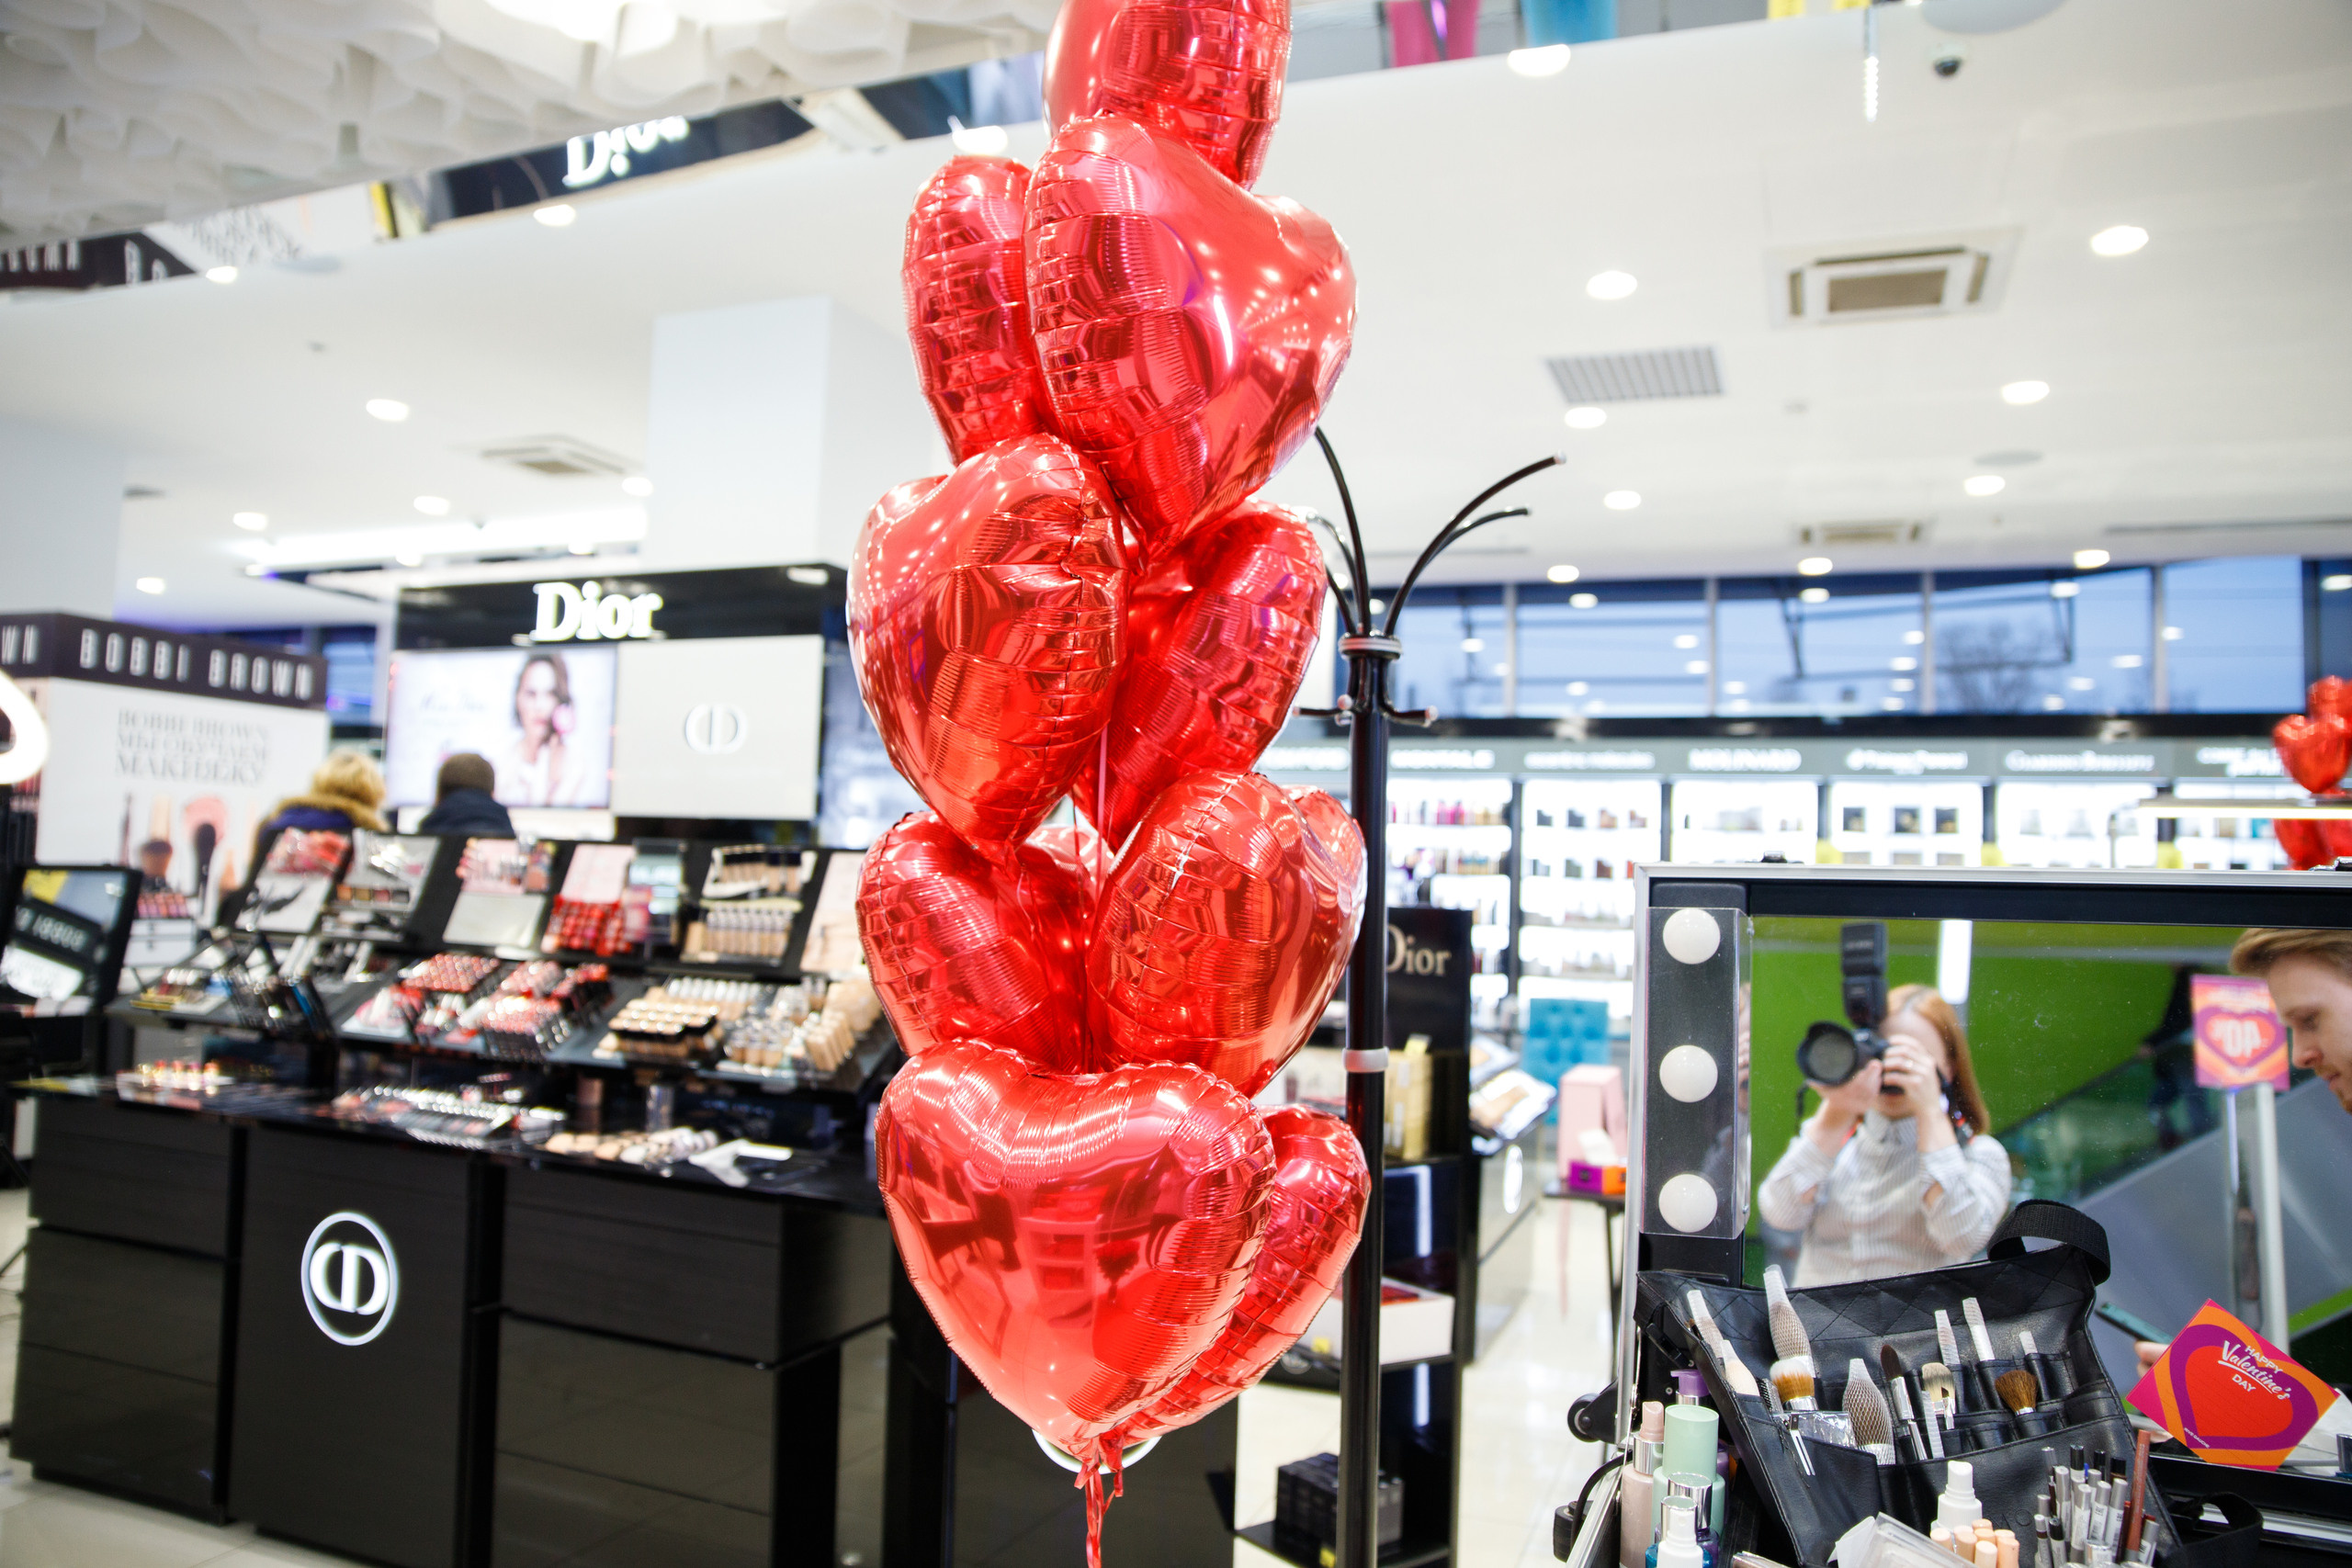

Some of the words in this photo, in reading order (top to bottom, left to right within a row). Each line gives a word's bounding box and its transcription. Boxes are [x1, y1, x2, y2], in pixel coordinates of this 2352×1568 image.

[530, 581, 663, 641] Dior
[79, 626, 191, 682] BOBBI
[208, 649, 316, 701] BROWN
[1387, 923, 1452, 976] Dior
[2222, 1340, 2291, 1400] Valentine's
[2232, 1373, 2256, 1393] DAY
[2245, 1345, 2283, 1374] HAPPY
